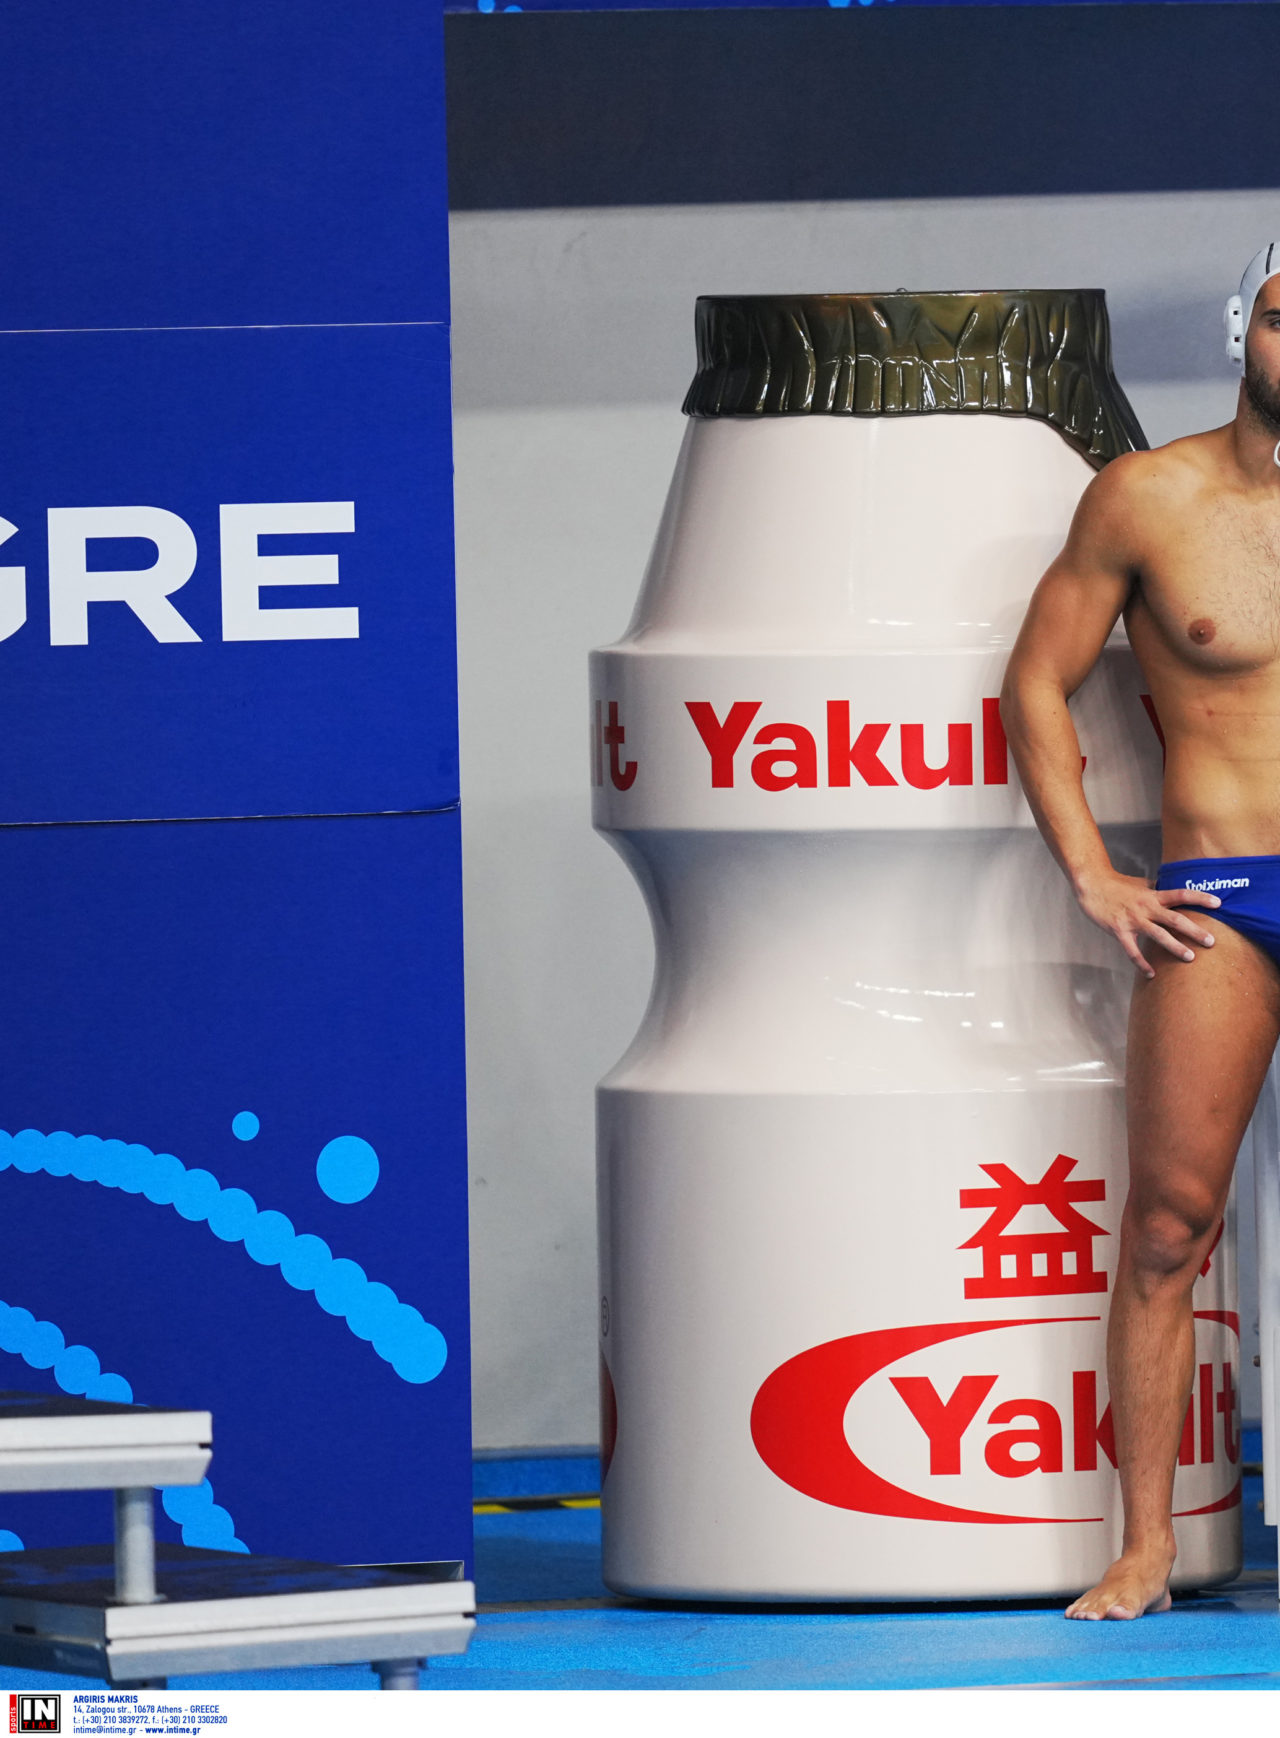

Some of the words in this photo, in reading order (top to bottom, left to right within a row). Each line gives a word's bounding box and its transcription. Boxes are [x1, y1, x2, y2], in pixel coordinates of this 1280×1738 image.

[0, 500, 360, 646] RE
[684, 697, 1087, 793] Yakul
[1185, 877, 1250, 891] Stoiximan
[957, 1153, 1224, 1300] 益
